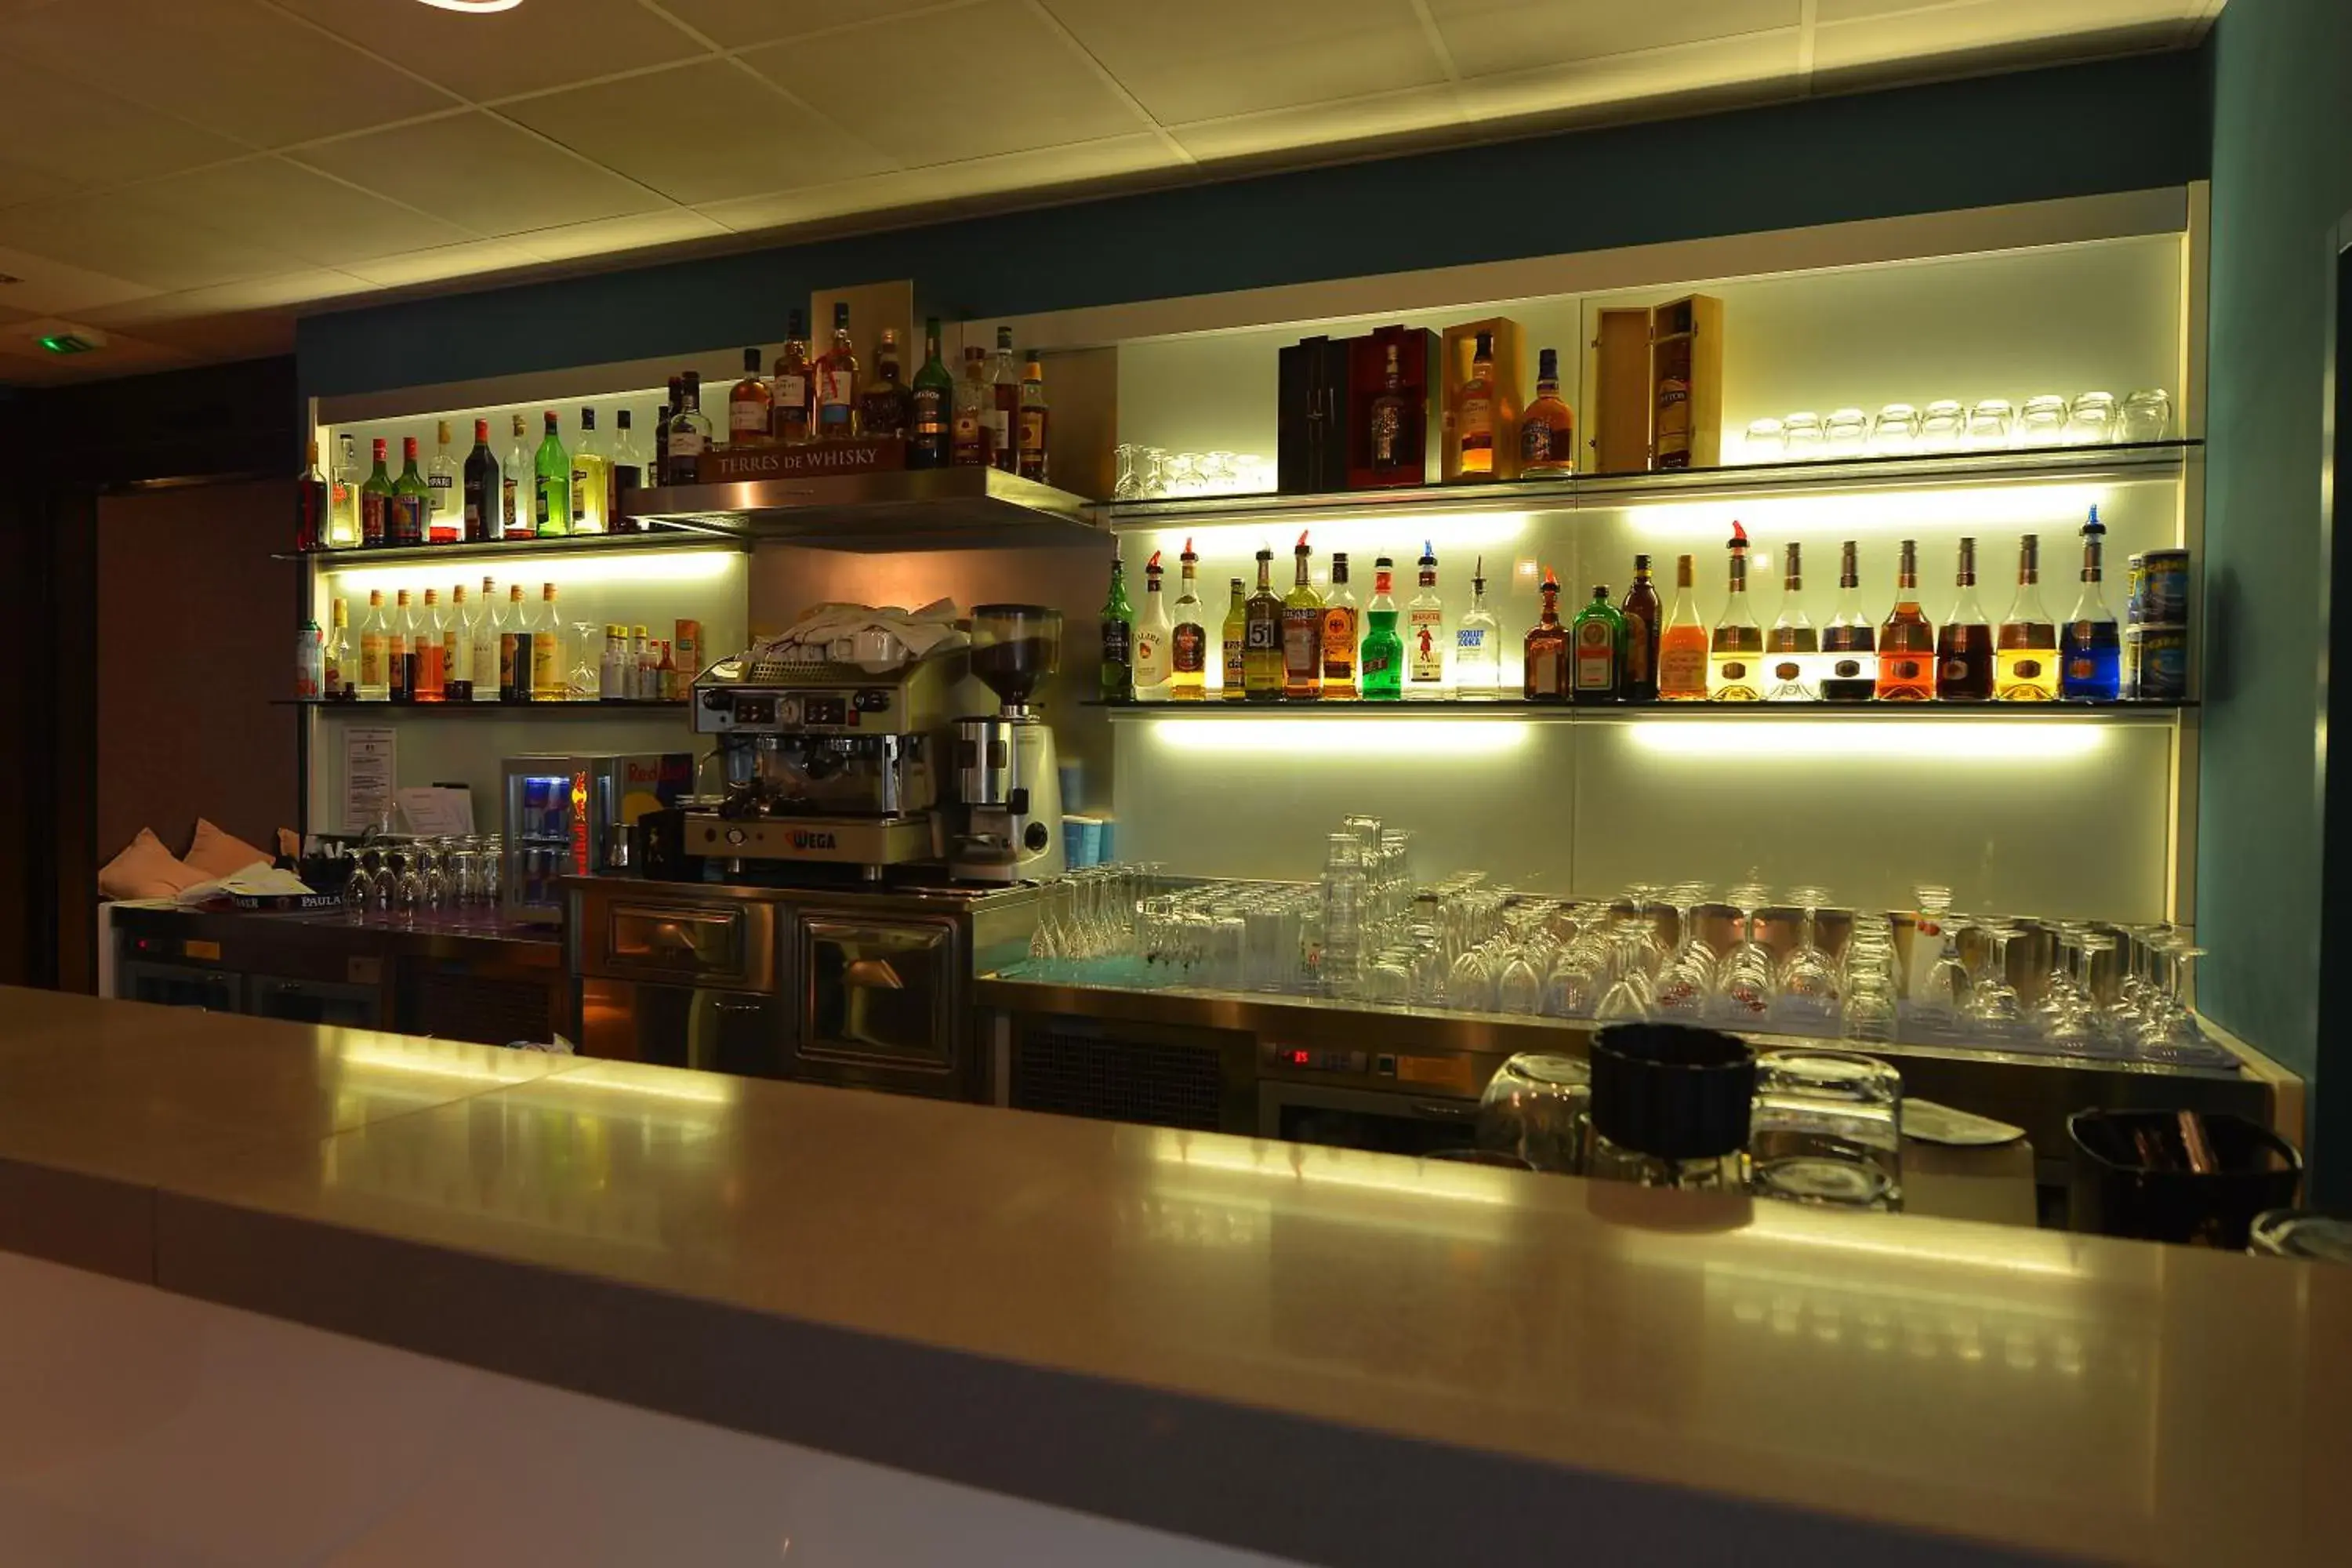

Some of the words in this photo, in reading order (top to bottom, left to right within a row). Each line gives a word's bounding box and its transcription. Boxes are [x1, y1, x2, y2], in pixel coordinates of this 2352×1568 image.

[717, 454, 779, 474] TERRES
[785, 456, 803, 469] DE
[807, 448, 878, 466] WHISKY
[1251, 624, 1270, 644] 51
[793, 830, 837, 850] WEGA
[301, 895, 355, 907] PAULA
